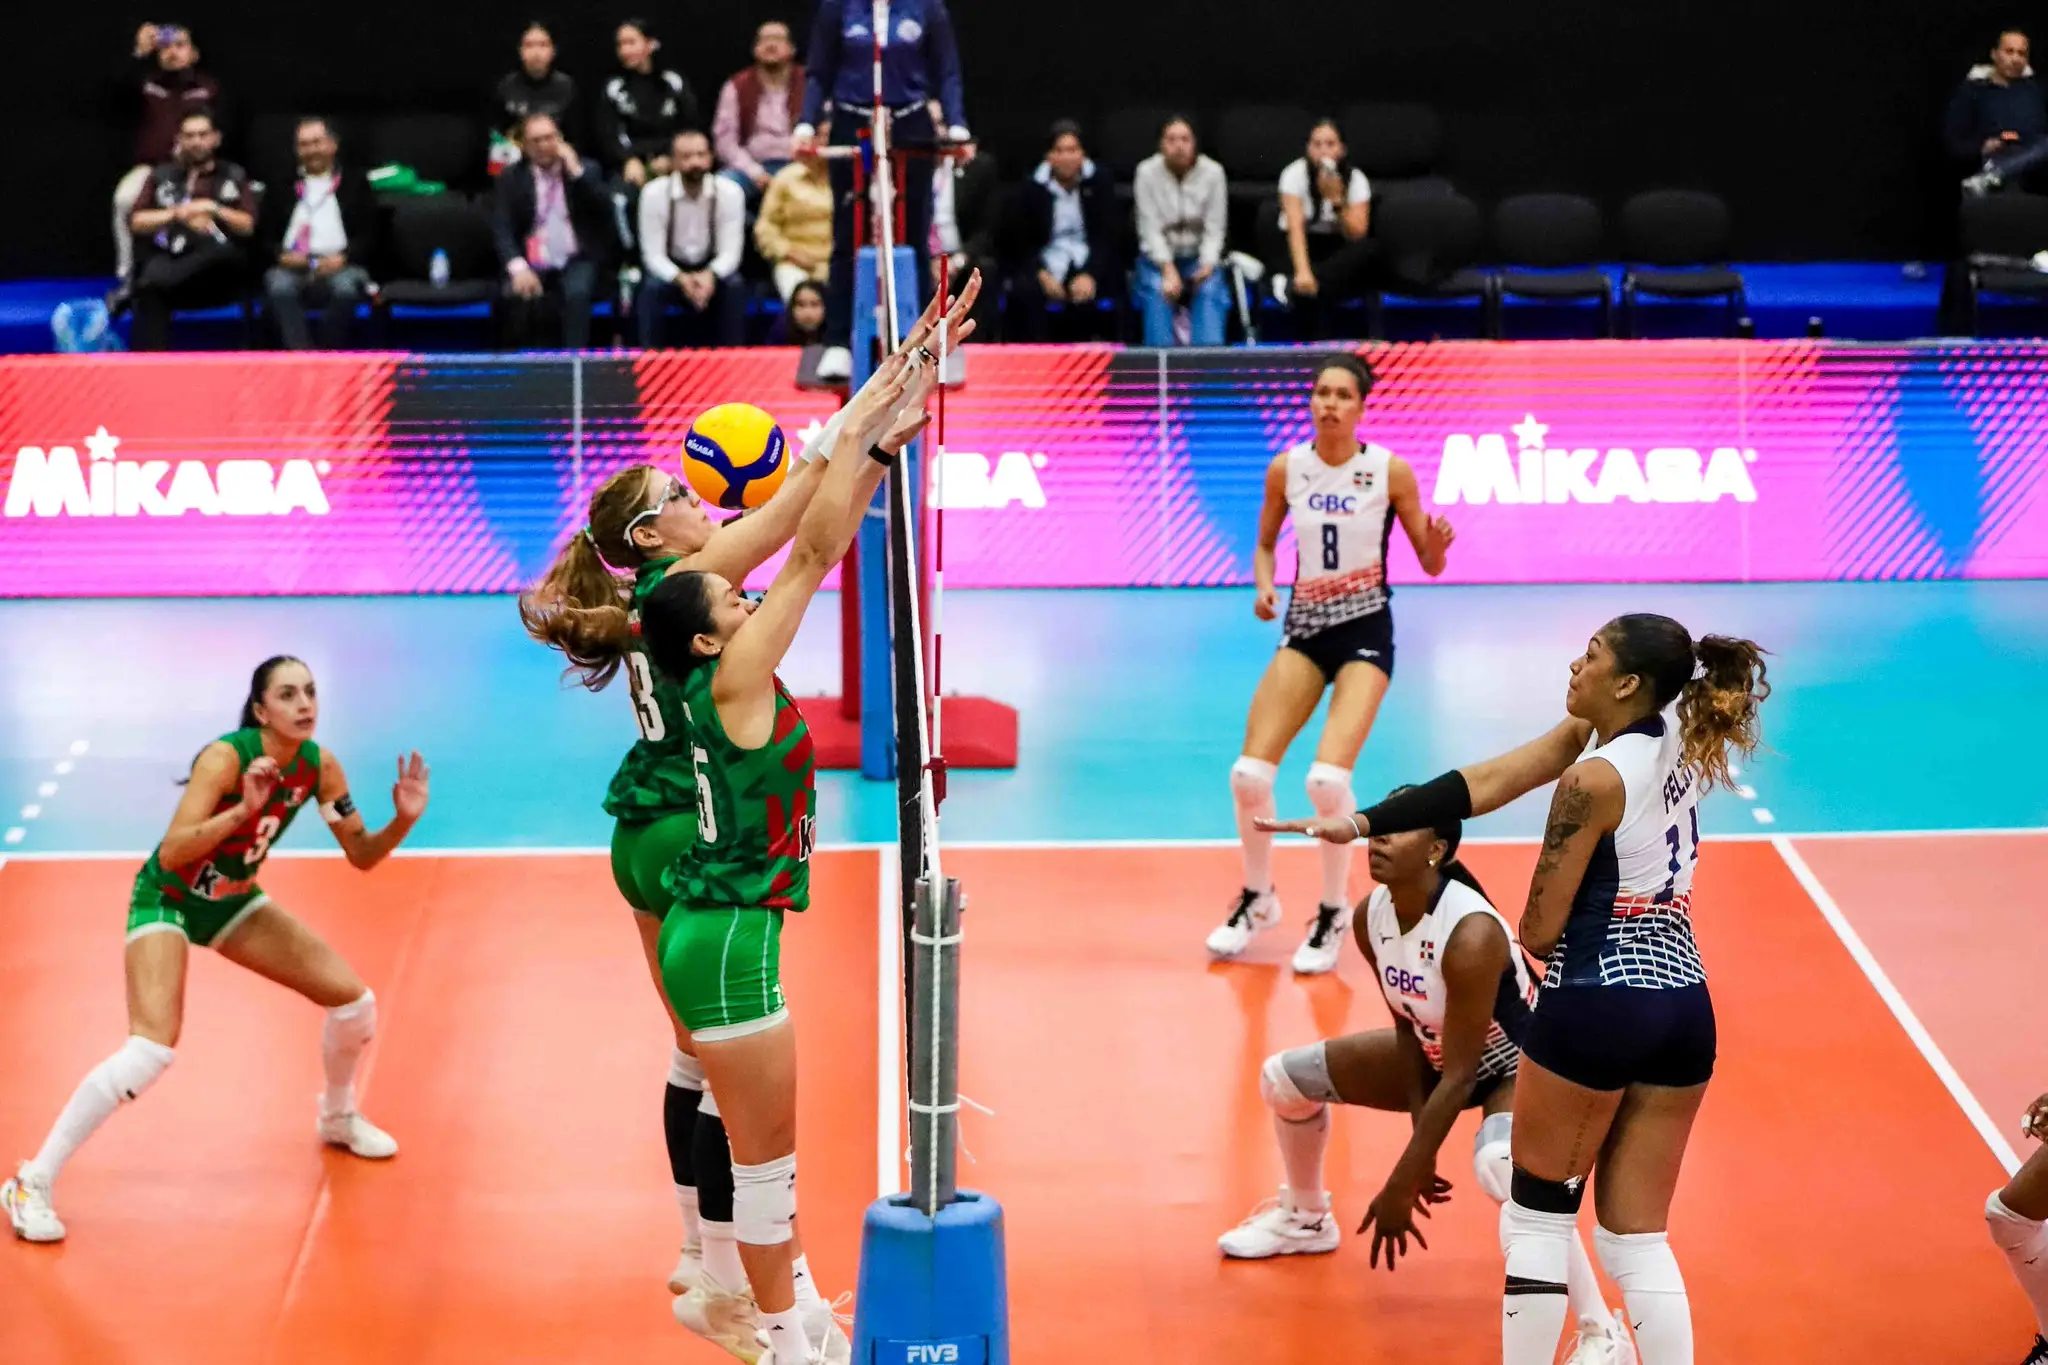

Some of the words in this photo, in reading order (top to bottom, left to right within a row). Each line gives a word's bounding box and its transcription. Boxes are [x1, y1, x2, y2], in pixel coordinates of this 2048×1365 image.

[1308, 493, 1357, 513] GBC
[1321, 523, 1339, 571] 8
[243, 815, 281, 866] 3
[1385, 965, 1426, 995] GBC
[907, 1344, 958, 1364] FIVB
